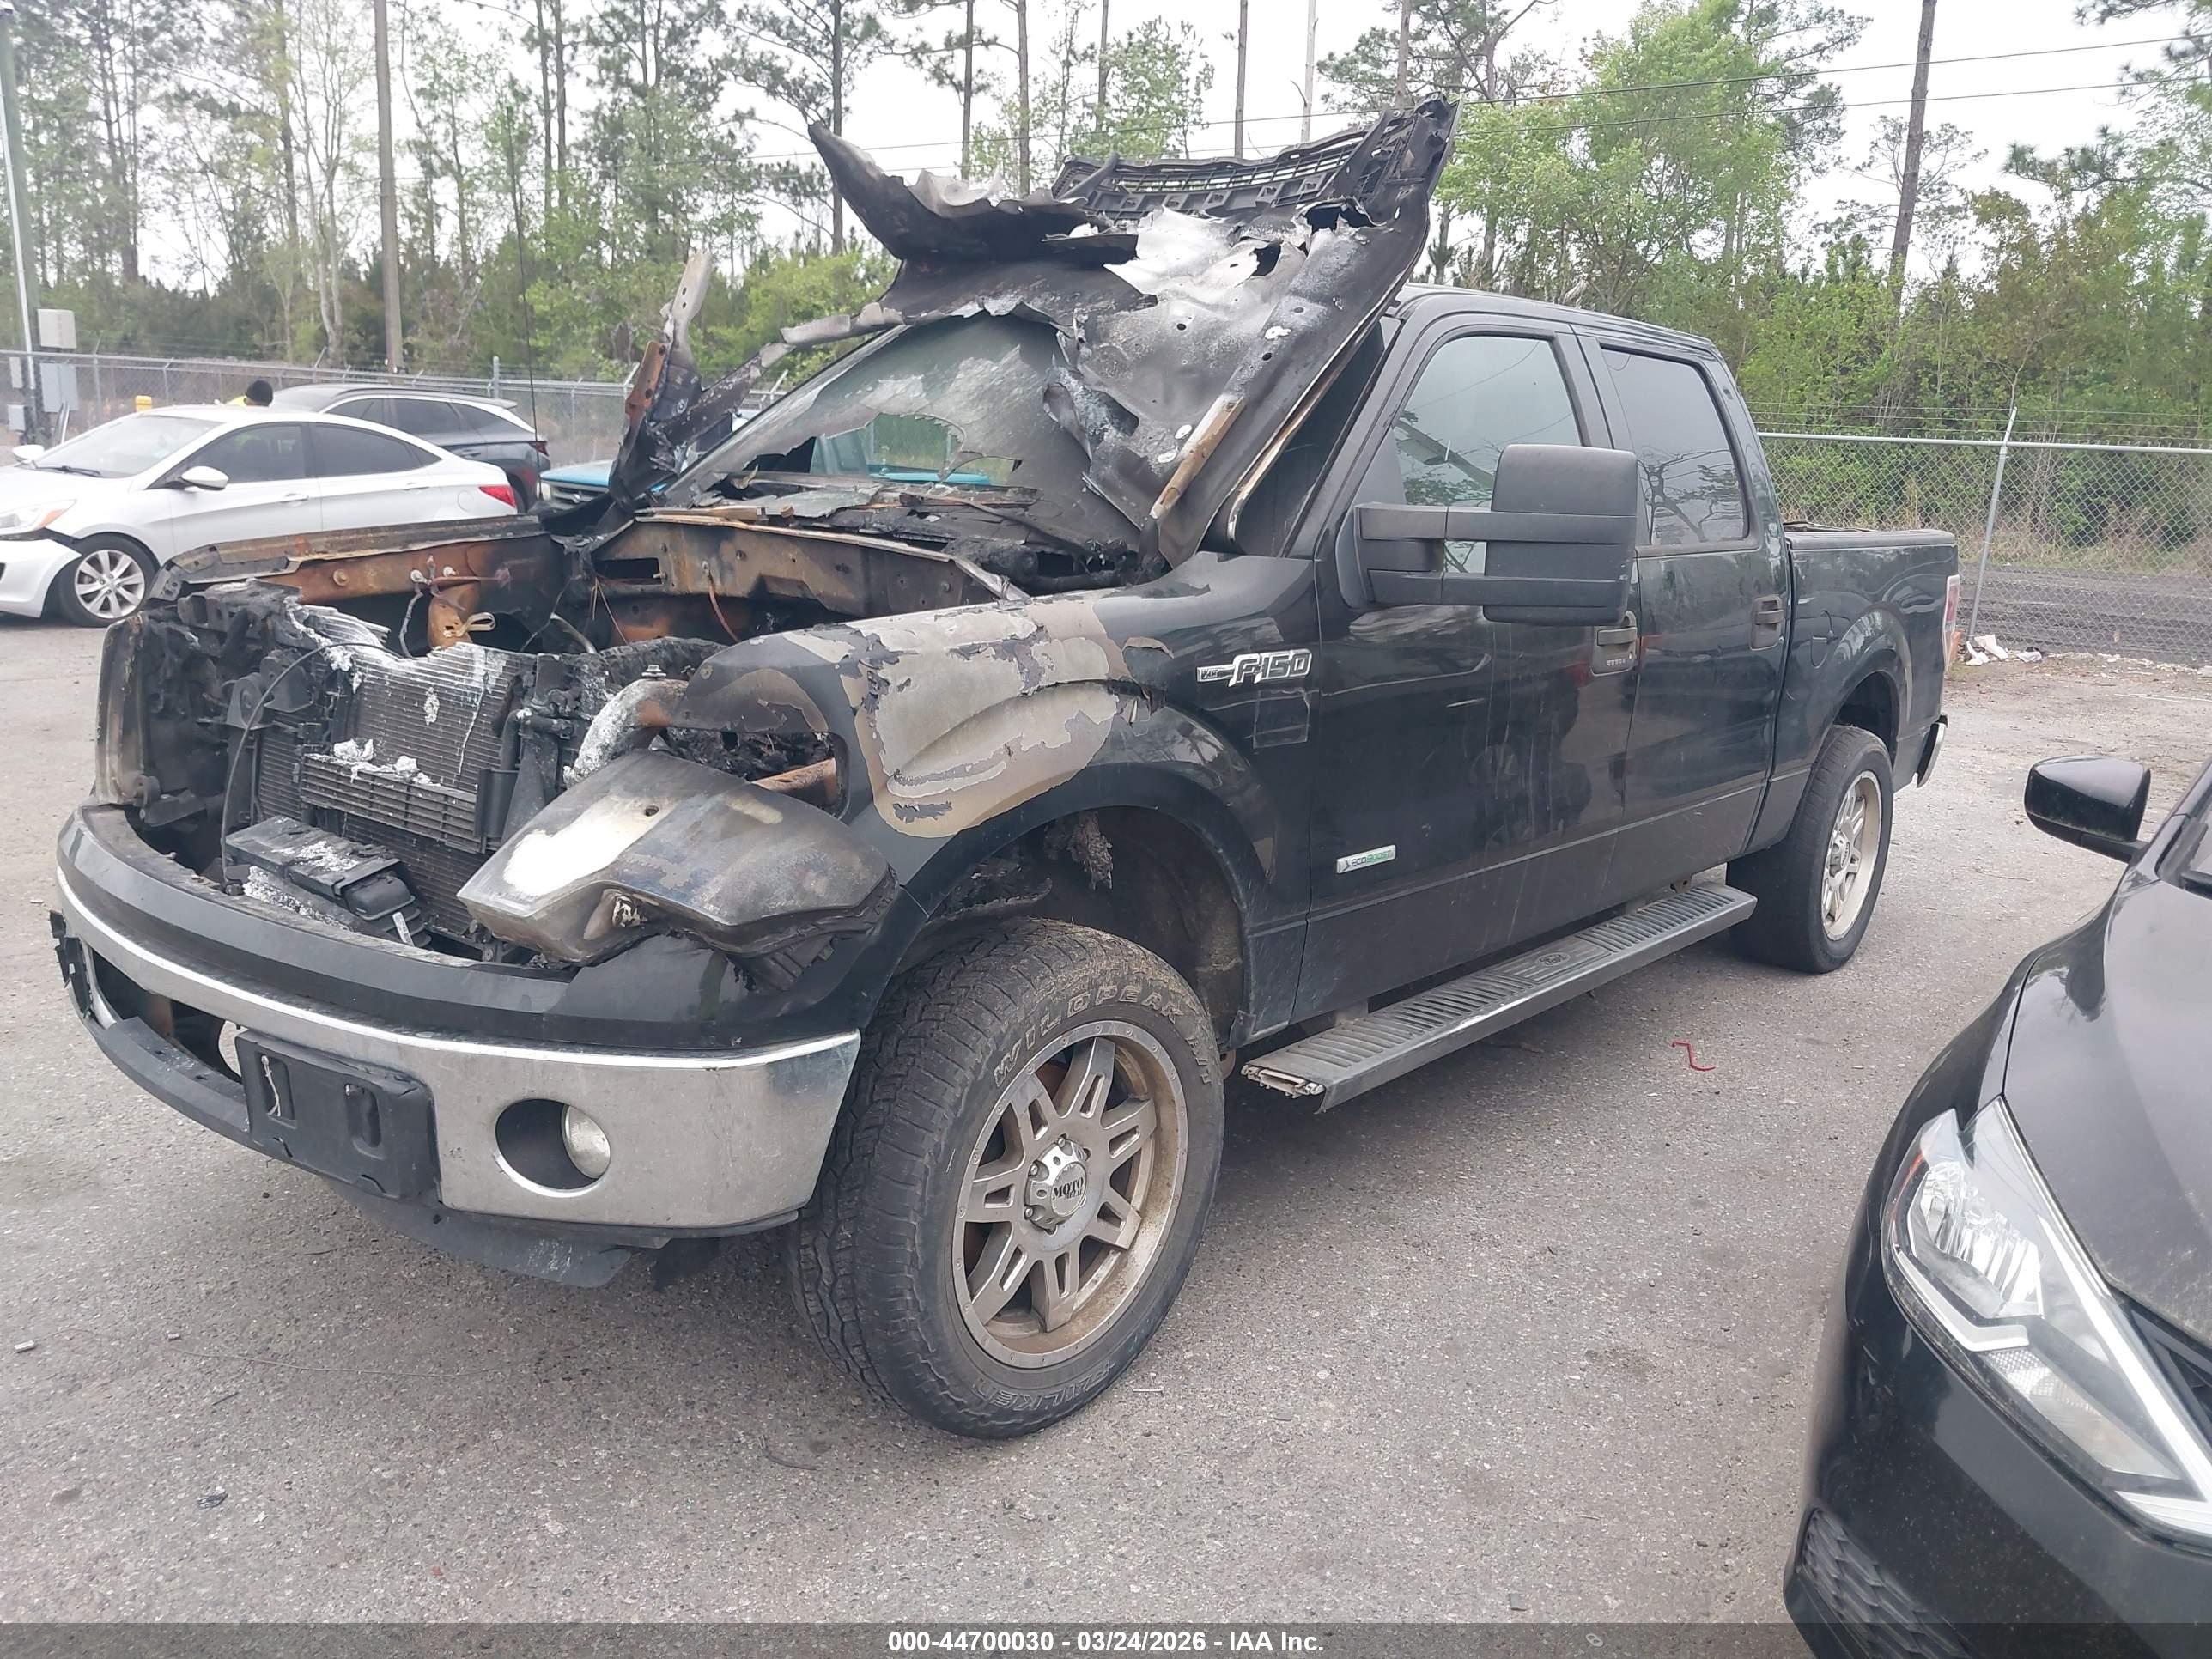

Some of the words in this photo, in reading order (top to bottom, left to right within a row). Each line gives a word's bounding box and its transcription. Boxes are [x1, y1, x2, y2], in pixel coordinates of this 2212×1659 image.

[1228, 648, 1312, 687] F-150
[994, 985, 1184, 1088] WILDPEAK
[1052, 1176, 1084, 1200] MOTO
[972, 1359, 1115, 1411] FALKEN
